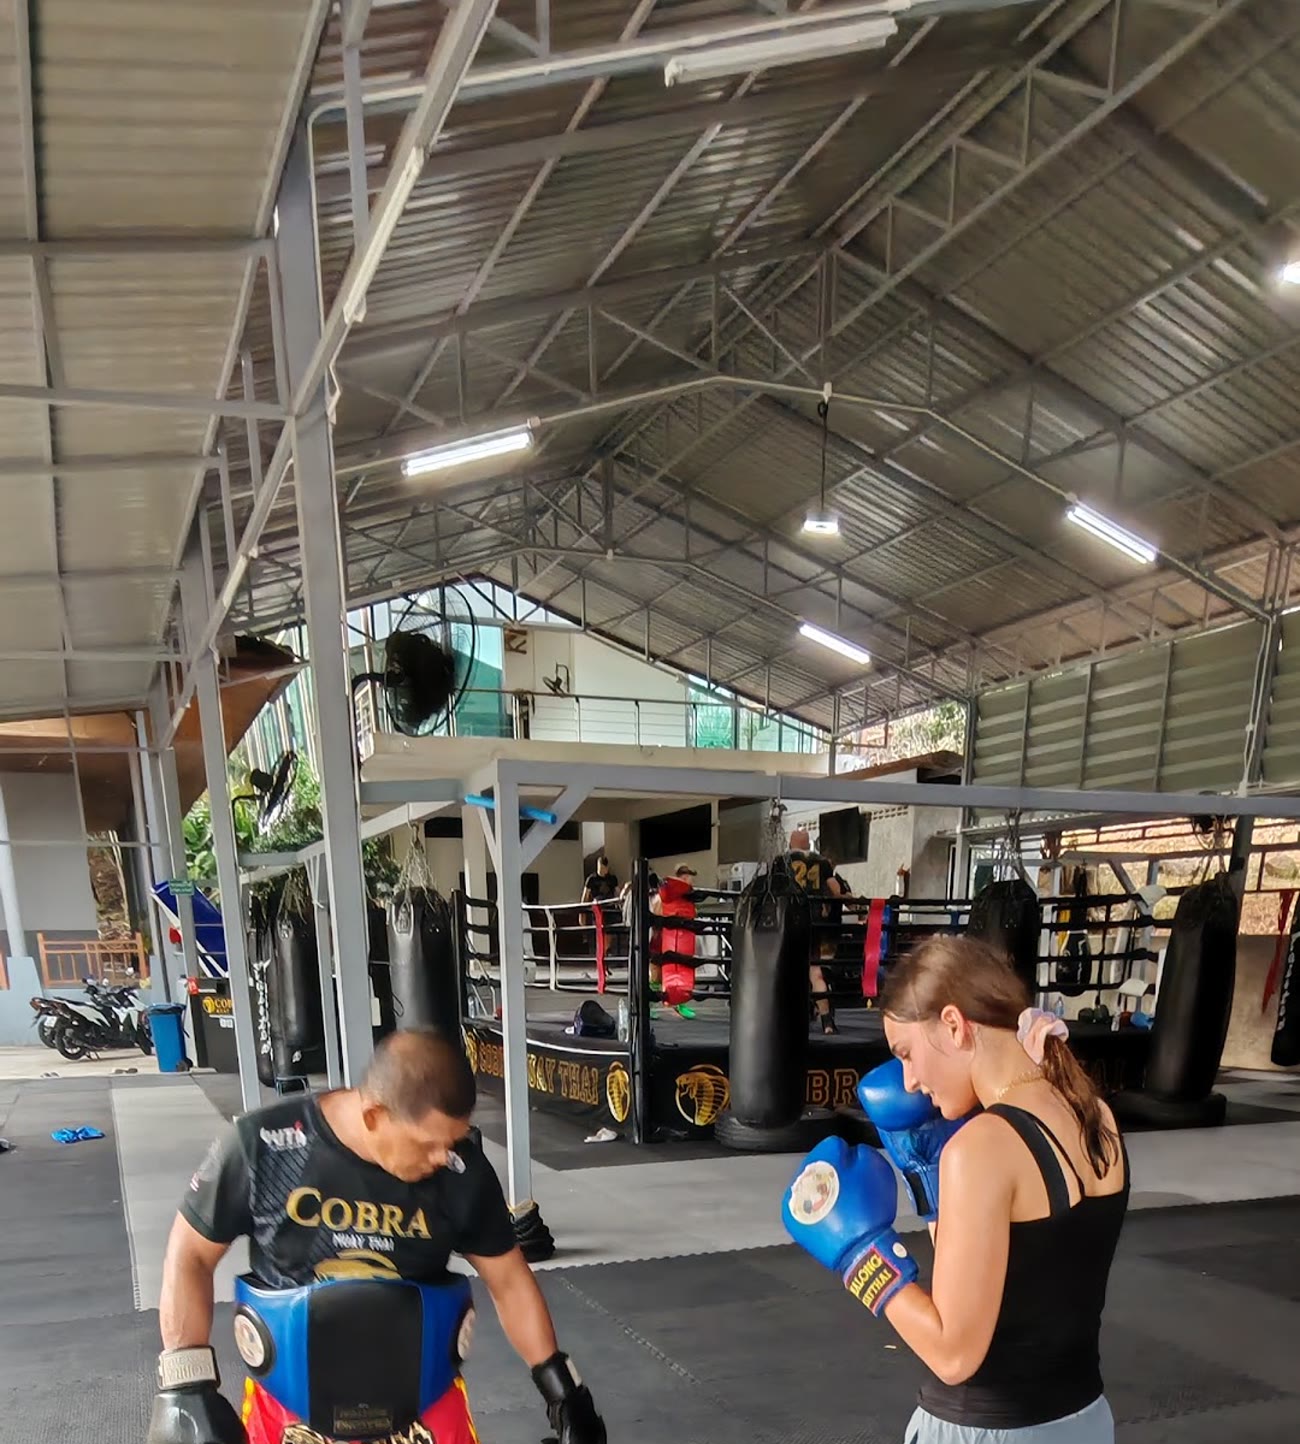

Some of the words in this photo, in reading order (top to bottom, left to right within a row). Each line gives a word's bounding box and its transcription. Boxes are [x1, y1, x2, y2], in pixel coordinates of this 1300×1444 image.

[527, 1053, 556, 1094] UAY
[558, 1061, 599, 1105] THAI
[286, 1186, 432, 1240] COBRA
[332, 1232, 365, 1249] MUAY
[367, 1235, 395, 1251] THAI
